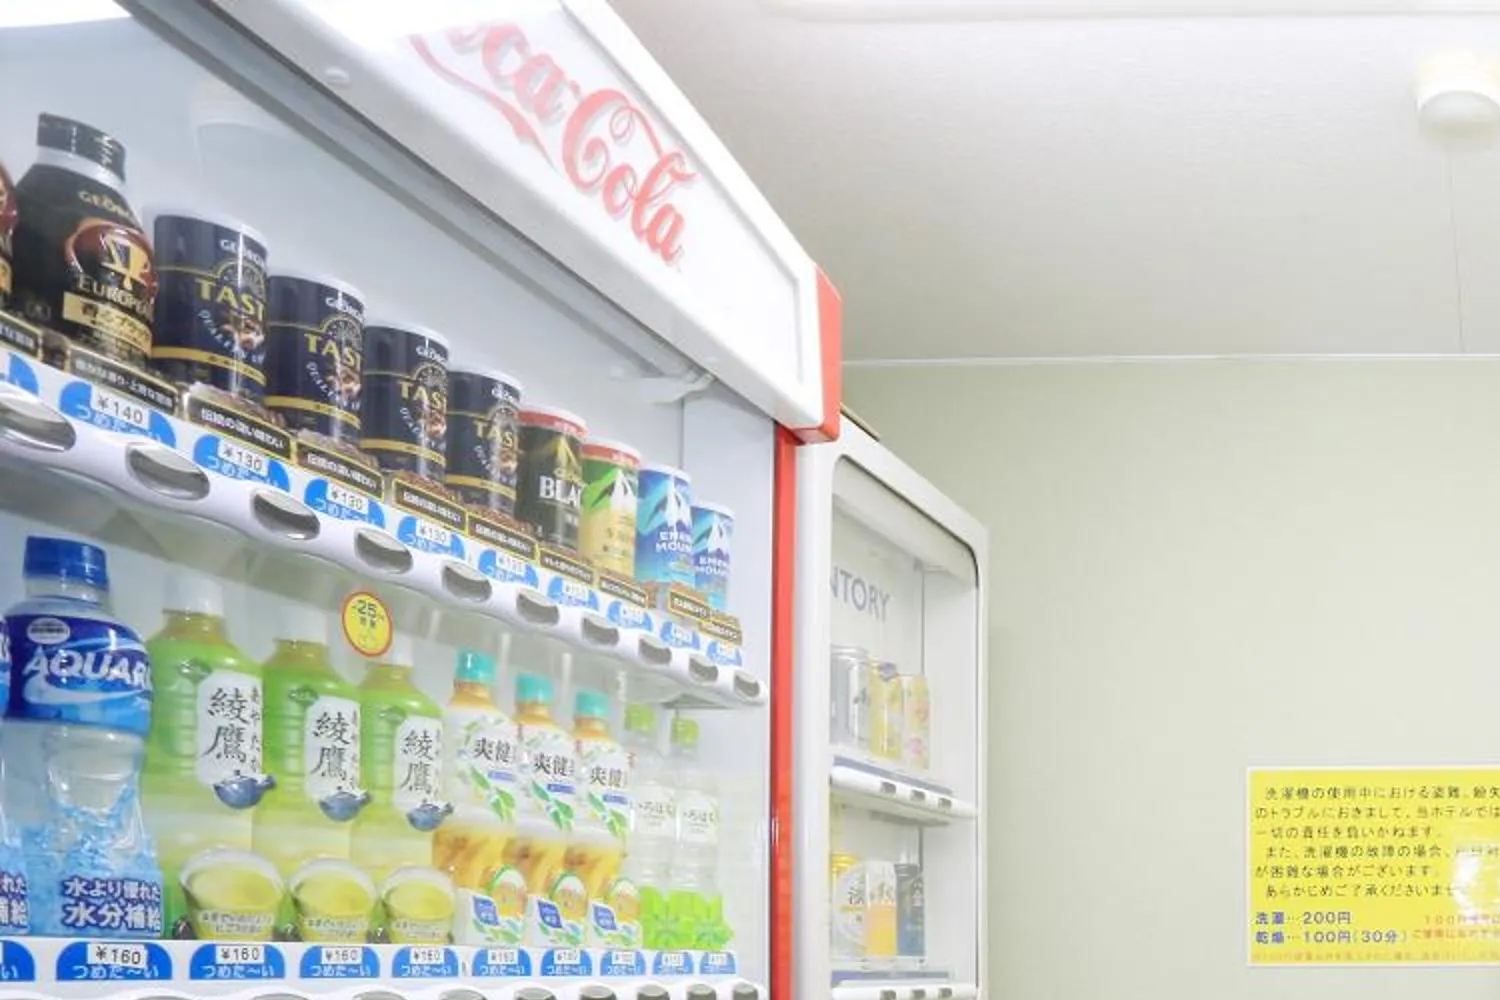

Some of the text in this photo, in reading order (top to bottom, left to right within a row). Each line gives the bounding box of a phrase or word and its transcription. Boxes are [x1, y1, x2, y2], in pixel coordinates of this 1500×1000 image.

[99, 394, 143, 424] ¥140
[95, 946, 141, 965] ¥160
[220, 947, 260, 961] ¥160
[325, 951, 358, 962] ¥160
